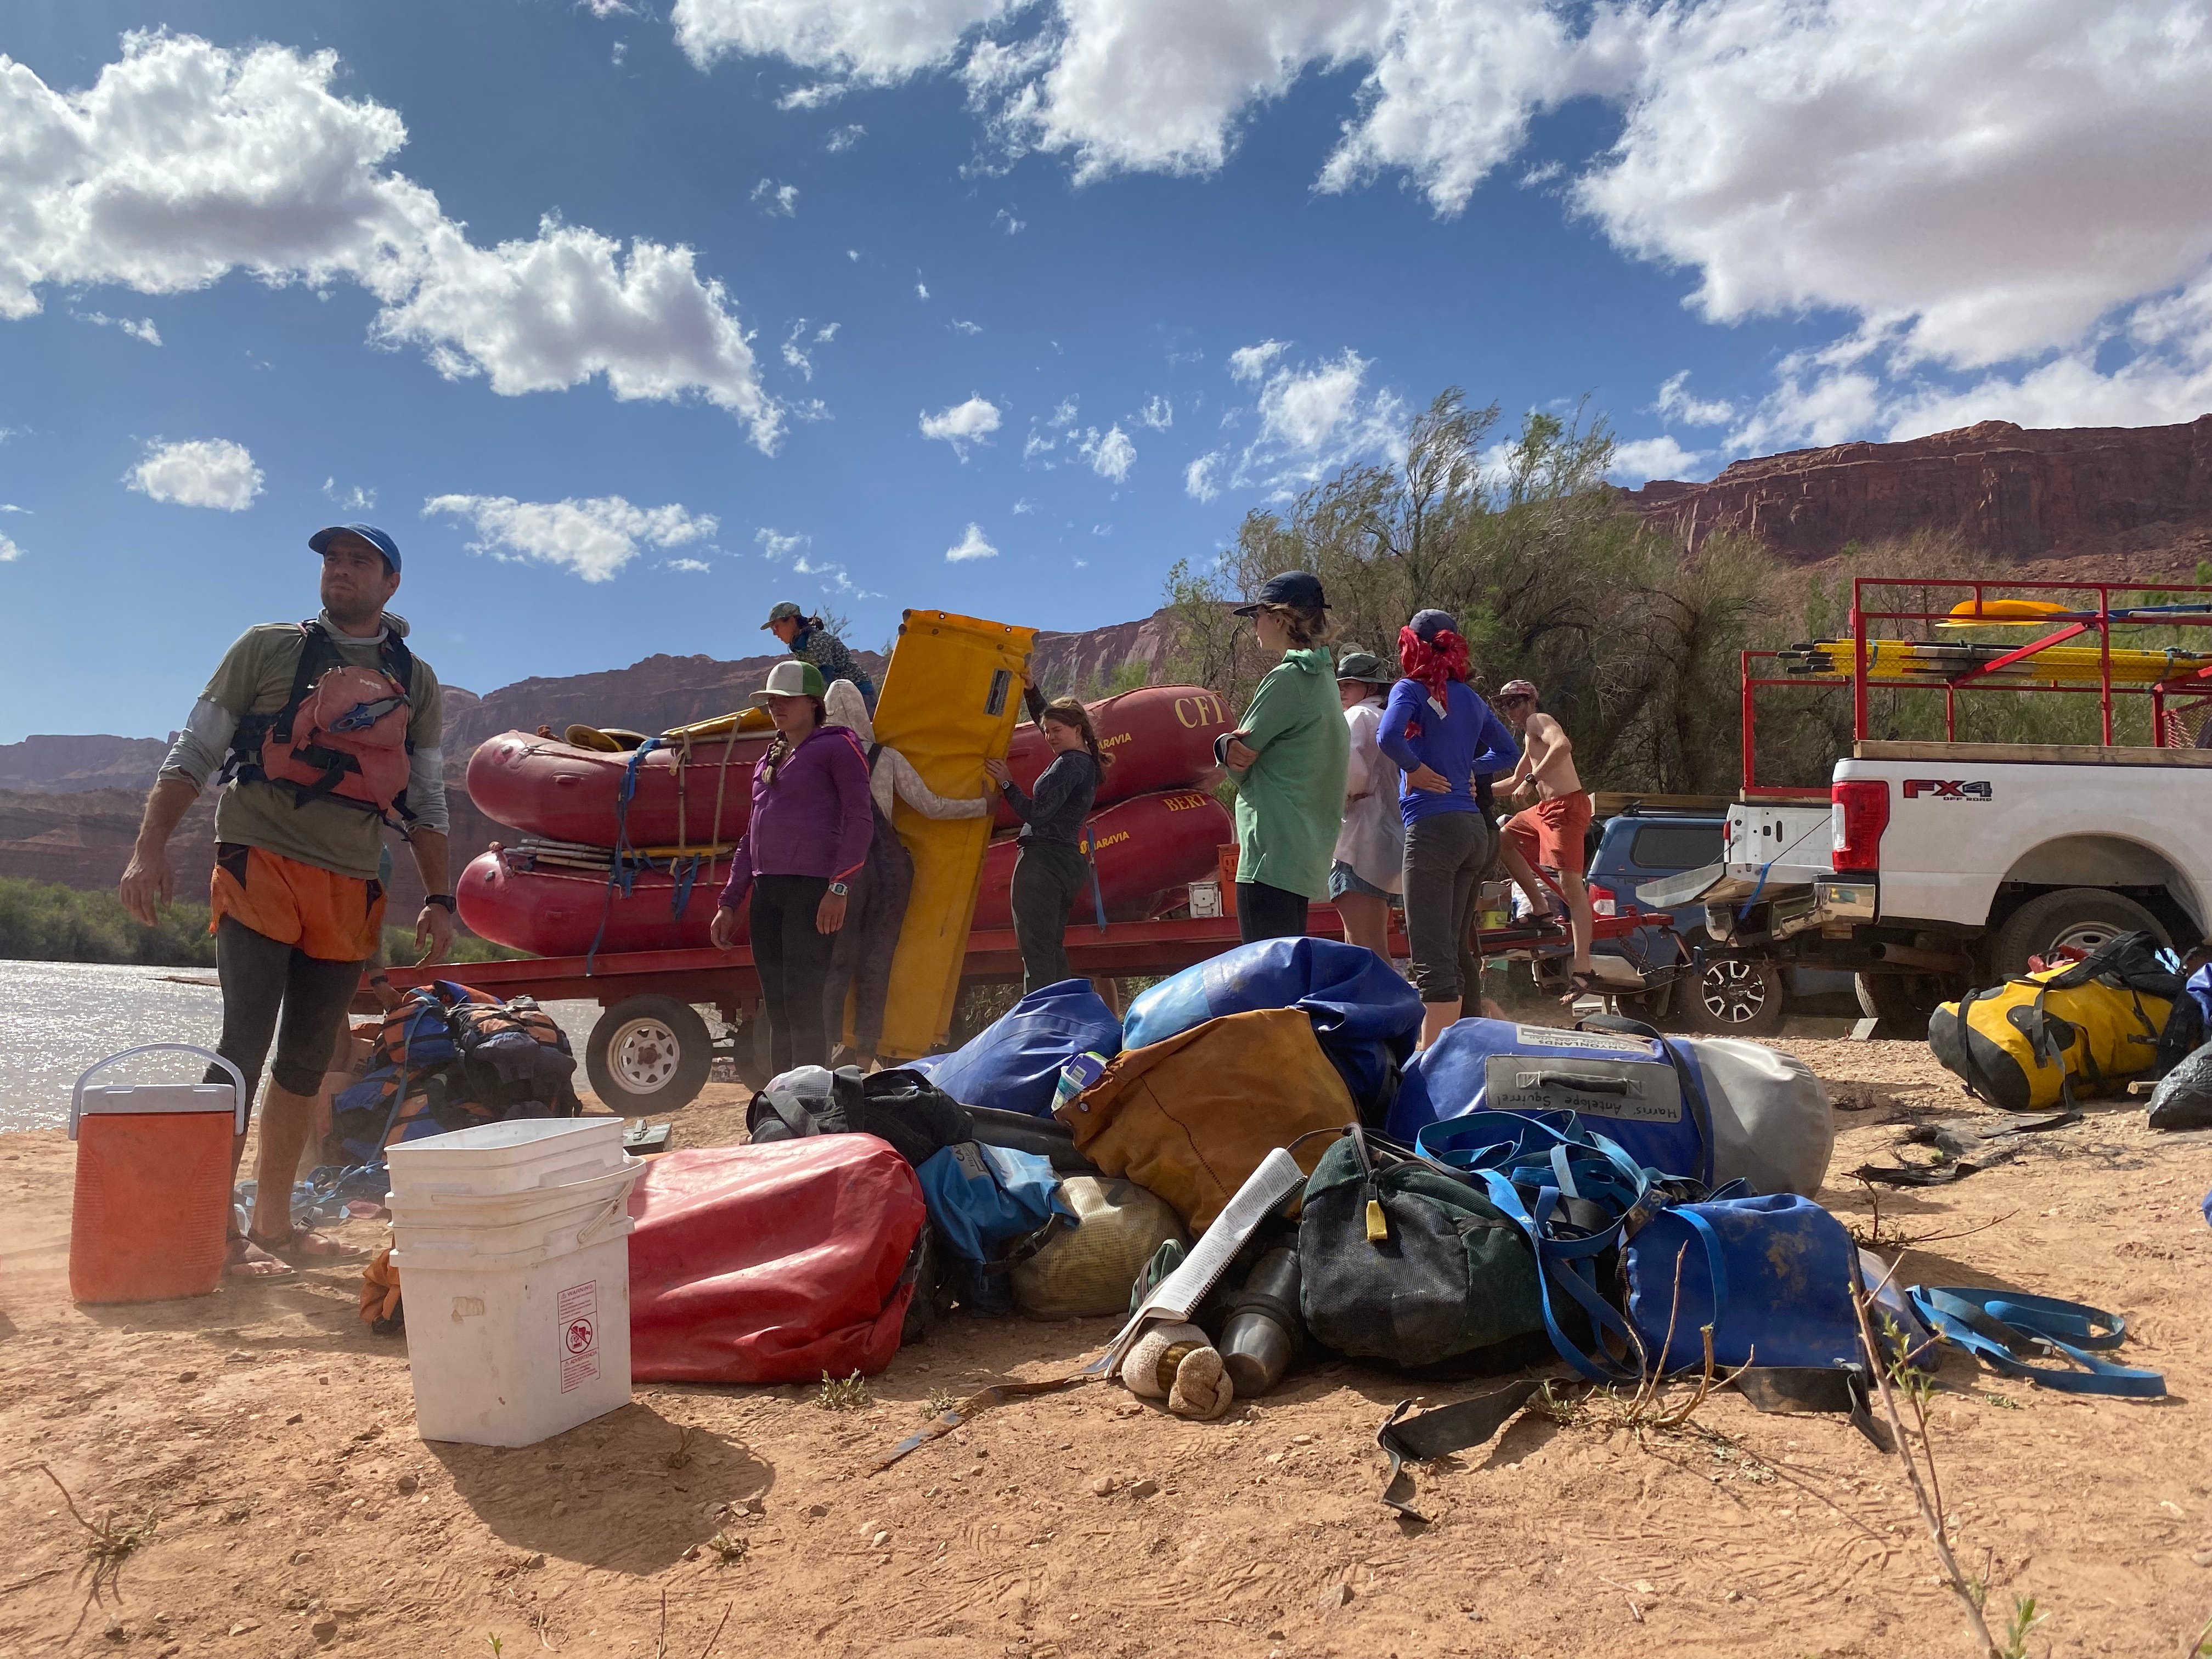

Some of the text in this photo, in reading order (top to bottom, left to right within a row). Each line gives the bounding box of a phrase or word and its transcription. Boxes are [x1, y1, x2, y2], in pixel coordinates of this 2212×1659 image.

[359, 678, 382, 690] NRS
[1175, 695, 1226, 729] CFI
[1098, 732, 1132, 750] ARAVIA
[1903, 779, 1993, 799] FX4
[1163, 794, 1208, 812] BERT
[1538, 1040, 1635, 1051] CANYONLANDS
[1497, 1092, 1551, 1107] Squirrel
[1564, 1093, 1622, 1115] Antelope
[567, 1284, 593, 1296] WARNING
[570, 1350, 597, 1364] ADVERTENCIA
